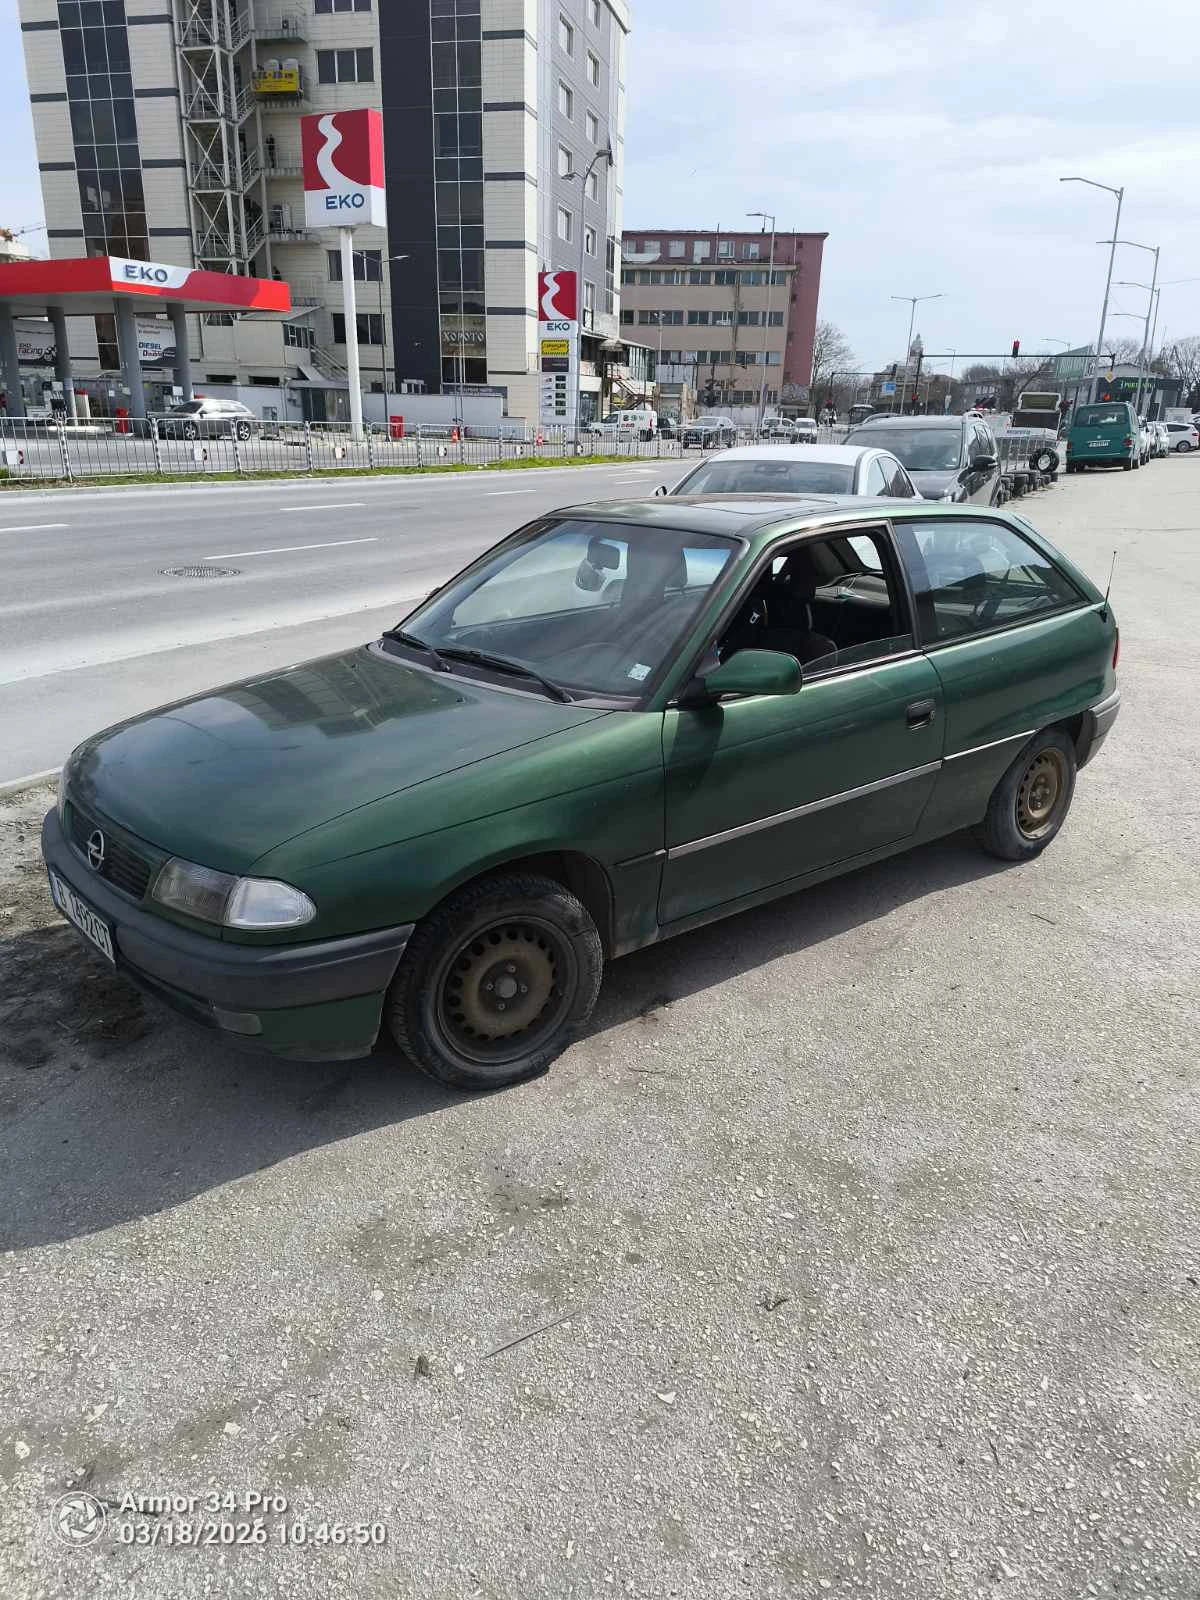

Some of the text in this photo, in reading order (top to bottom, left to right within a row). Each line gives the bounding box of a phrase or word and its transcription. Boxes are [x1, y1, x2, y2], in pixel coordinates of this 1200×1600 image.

[325, 193, 365, 210] EKO
[125, 263, 168, 283] EKO
[546, 322, 571, 331] EKO
[138, 341, 162, 350] DIESEL
